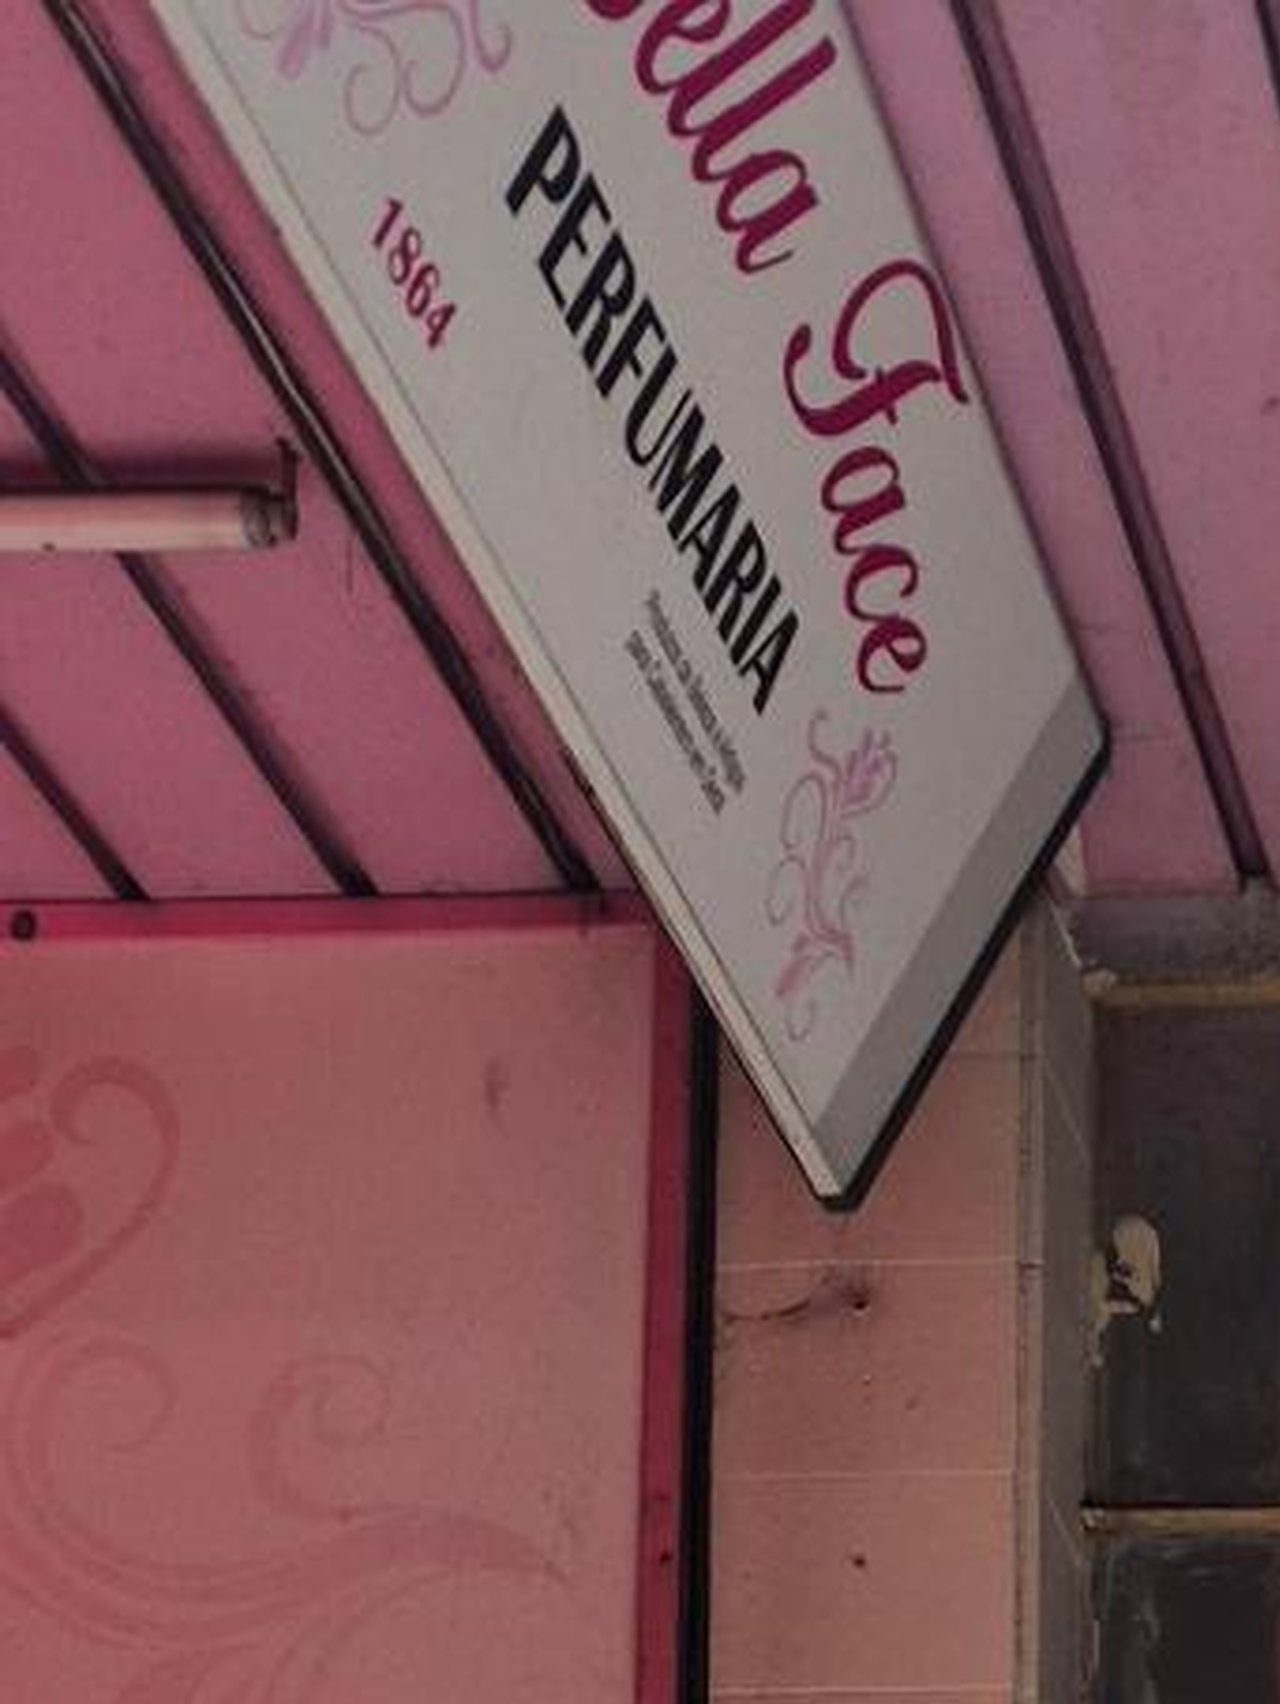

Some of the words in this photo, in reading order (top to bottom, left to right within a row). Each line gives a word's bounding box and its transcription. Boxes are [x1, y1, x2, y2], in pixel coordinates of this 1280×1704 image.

[368, 198, 458, 350] 1864
[504, 105, 801, 716] PERFUMARIA
[584, 0, 837, 275] ella
[783, 258, 970, 696] Face
